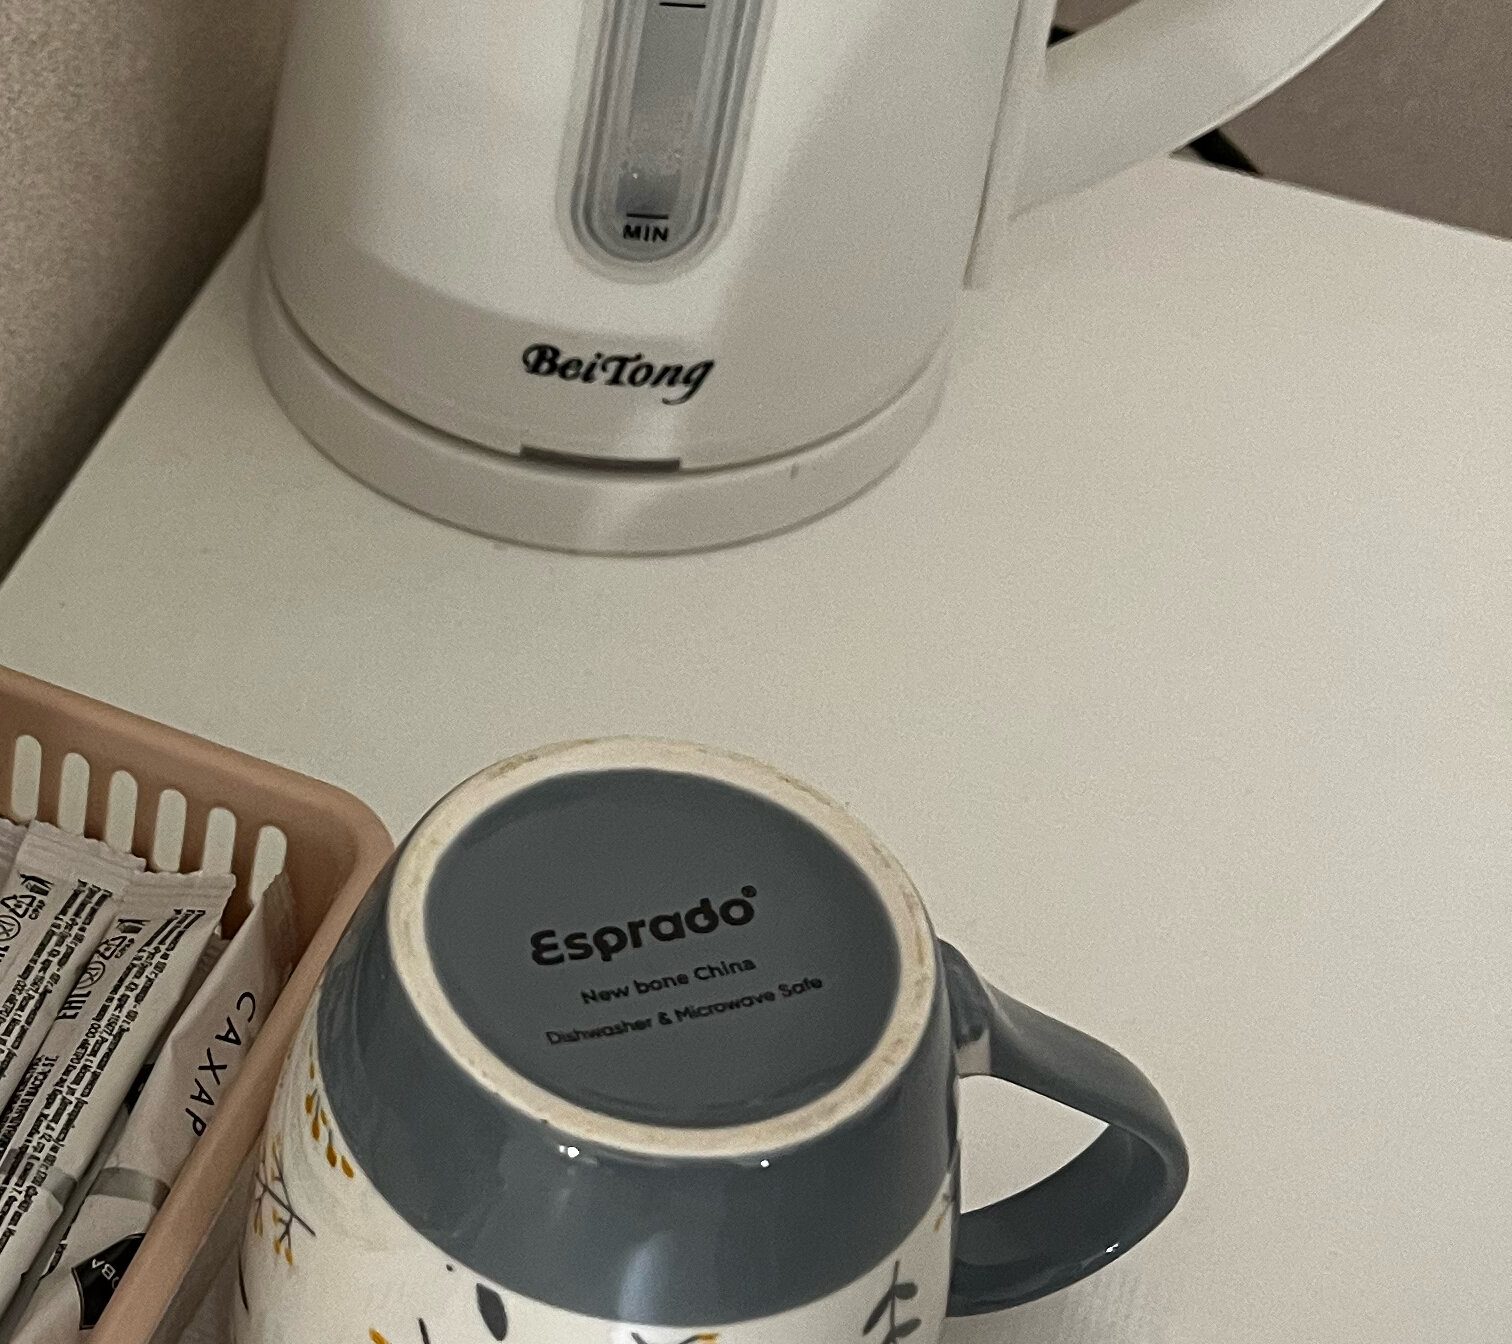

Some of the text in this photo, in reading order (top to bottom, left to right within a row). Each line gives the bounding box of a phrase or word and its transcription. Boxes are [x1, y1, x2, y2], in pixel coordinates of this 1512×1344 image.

[622, 224, 669, 243] MIN
[521, 343, 716, 405] BeiTong
[545, 976, 824, 1045] Dishwasher & Microwave Safe
[580, 959, 757, 1005] New bone China
[185, 991, 257, 1138] САХАР
